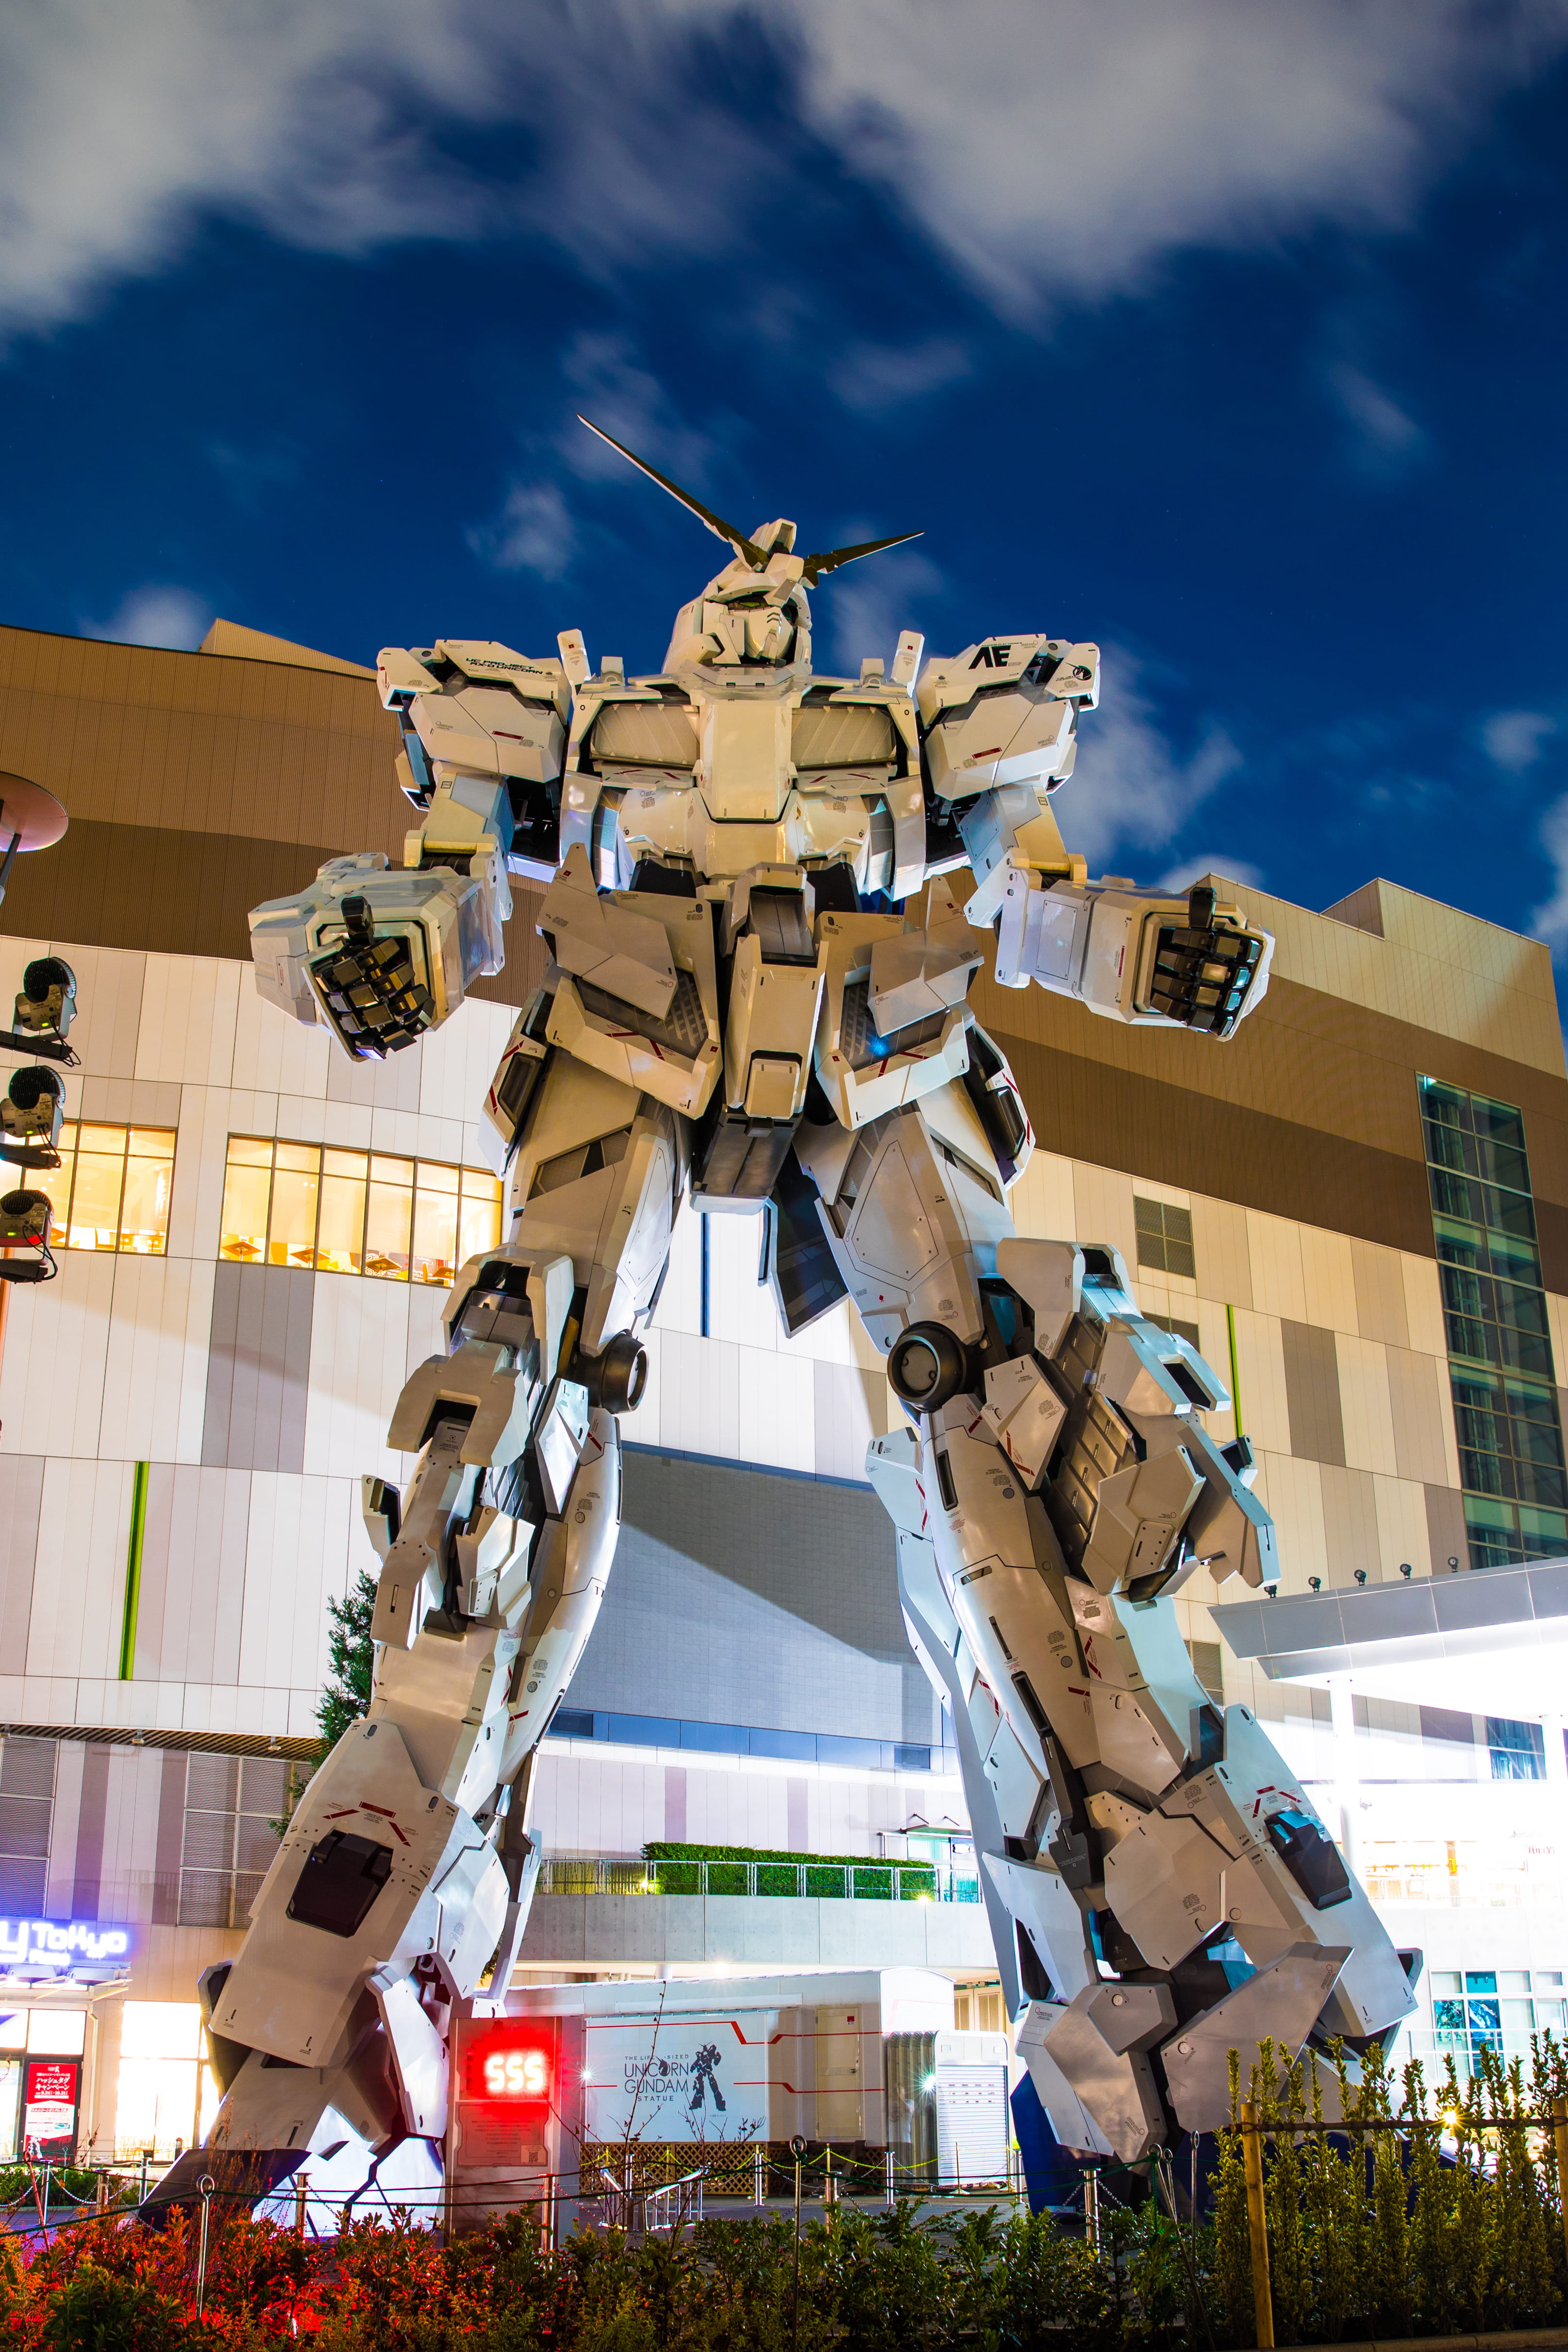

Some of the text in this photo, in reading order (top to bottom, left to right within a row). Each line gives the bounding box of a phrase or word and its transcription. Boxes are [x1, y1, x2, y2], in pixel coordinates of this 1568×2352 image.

[483, 660, 534, 669] PROJECT
[496, 666, 543, 675] UNICORN
[625, 2062, 689, 2077] UNICORN
[624, 2078, 689, 2093] GUNDAM
